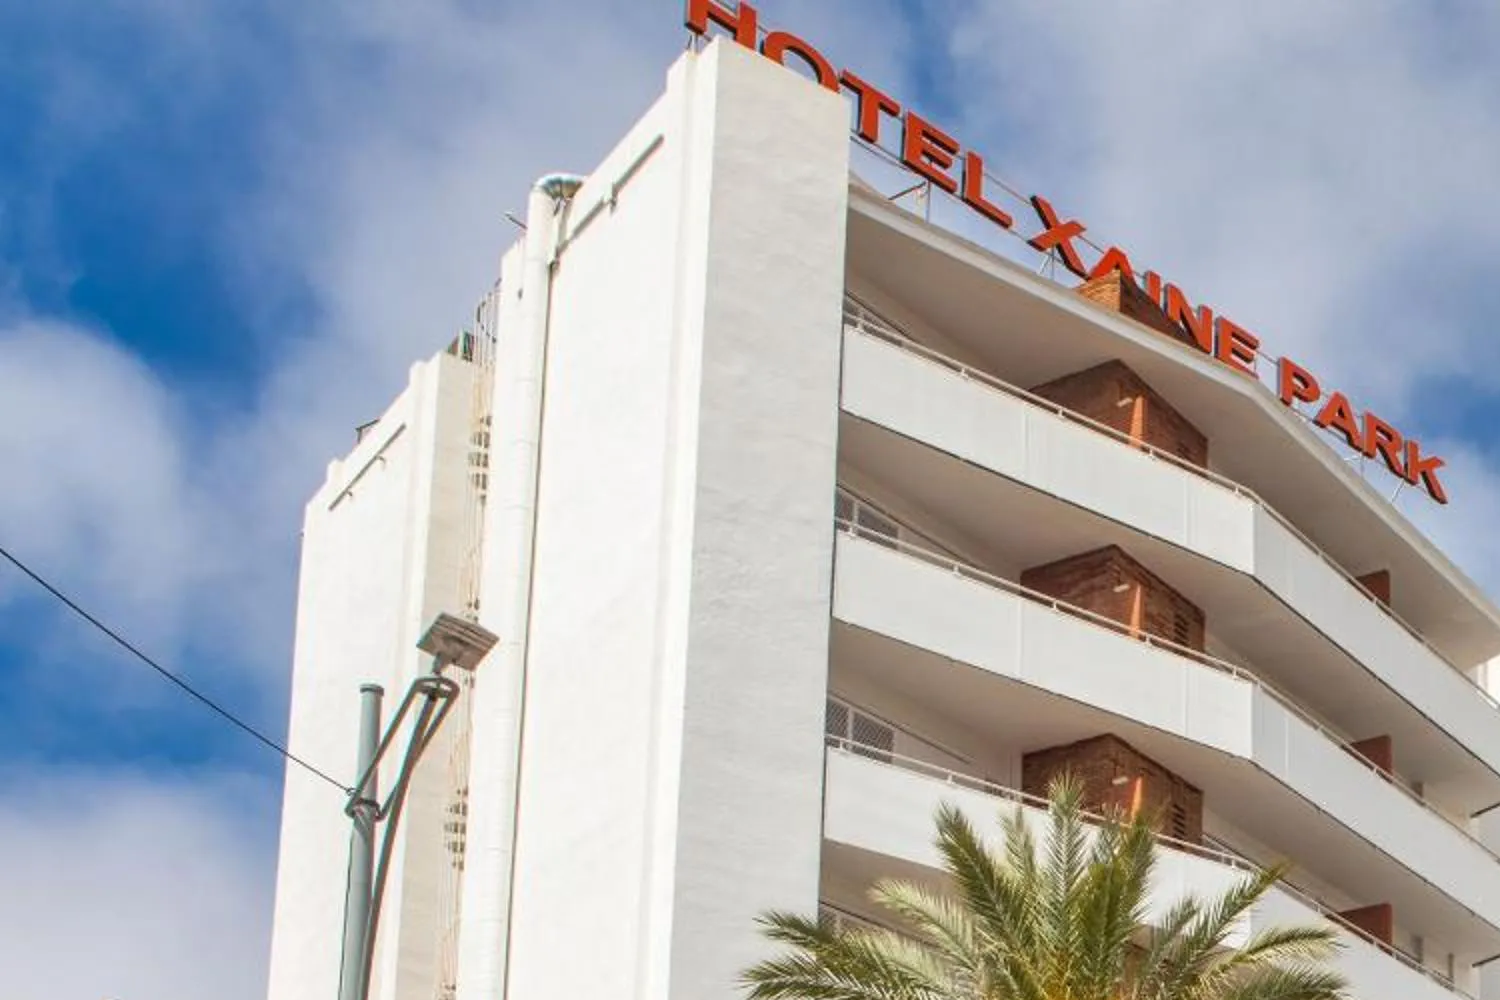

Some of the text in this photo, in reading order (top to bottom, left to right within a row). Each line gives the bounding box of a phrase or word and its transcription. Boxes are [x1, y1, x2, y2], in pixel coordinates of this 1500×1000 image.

[684, 0, 1448, 504] HOTEL XAINE PARK
